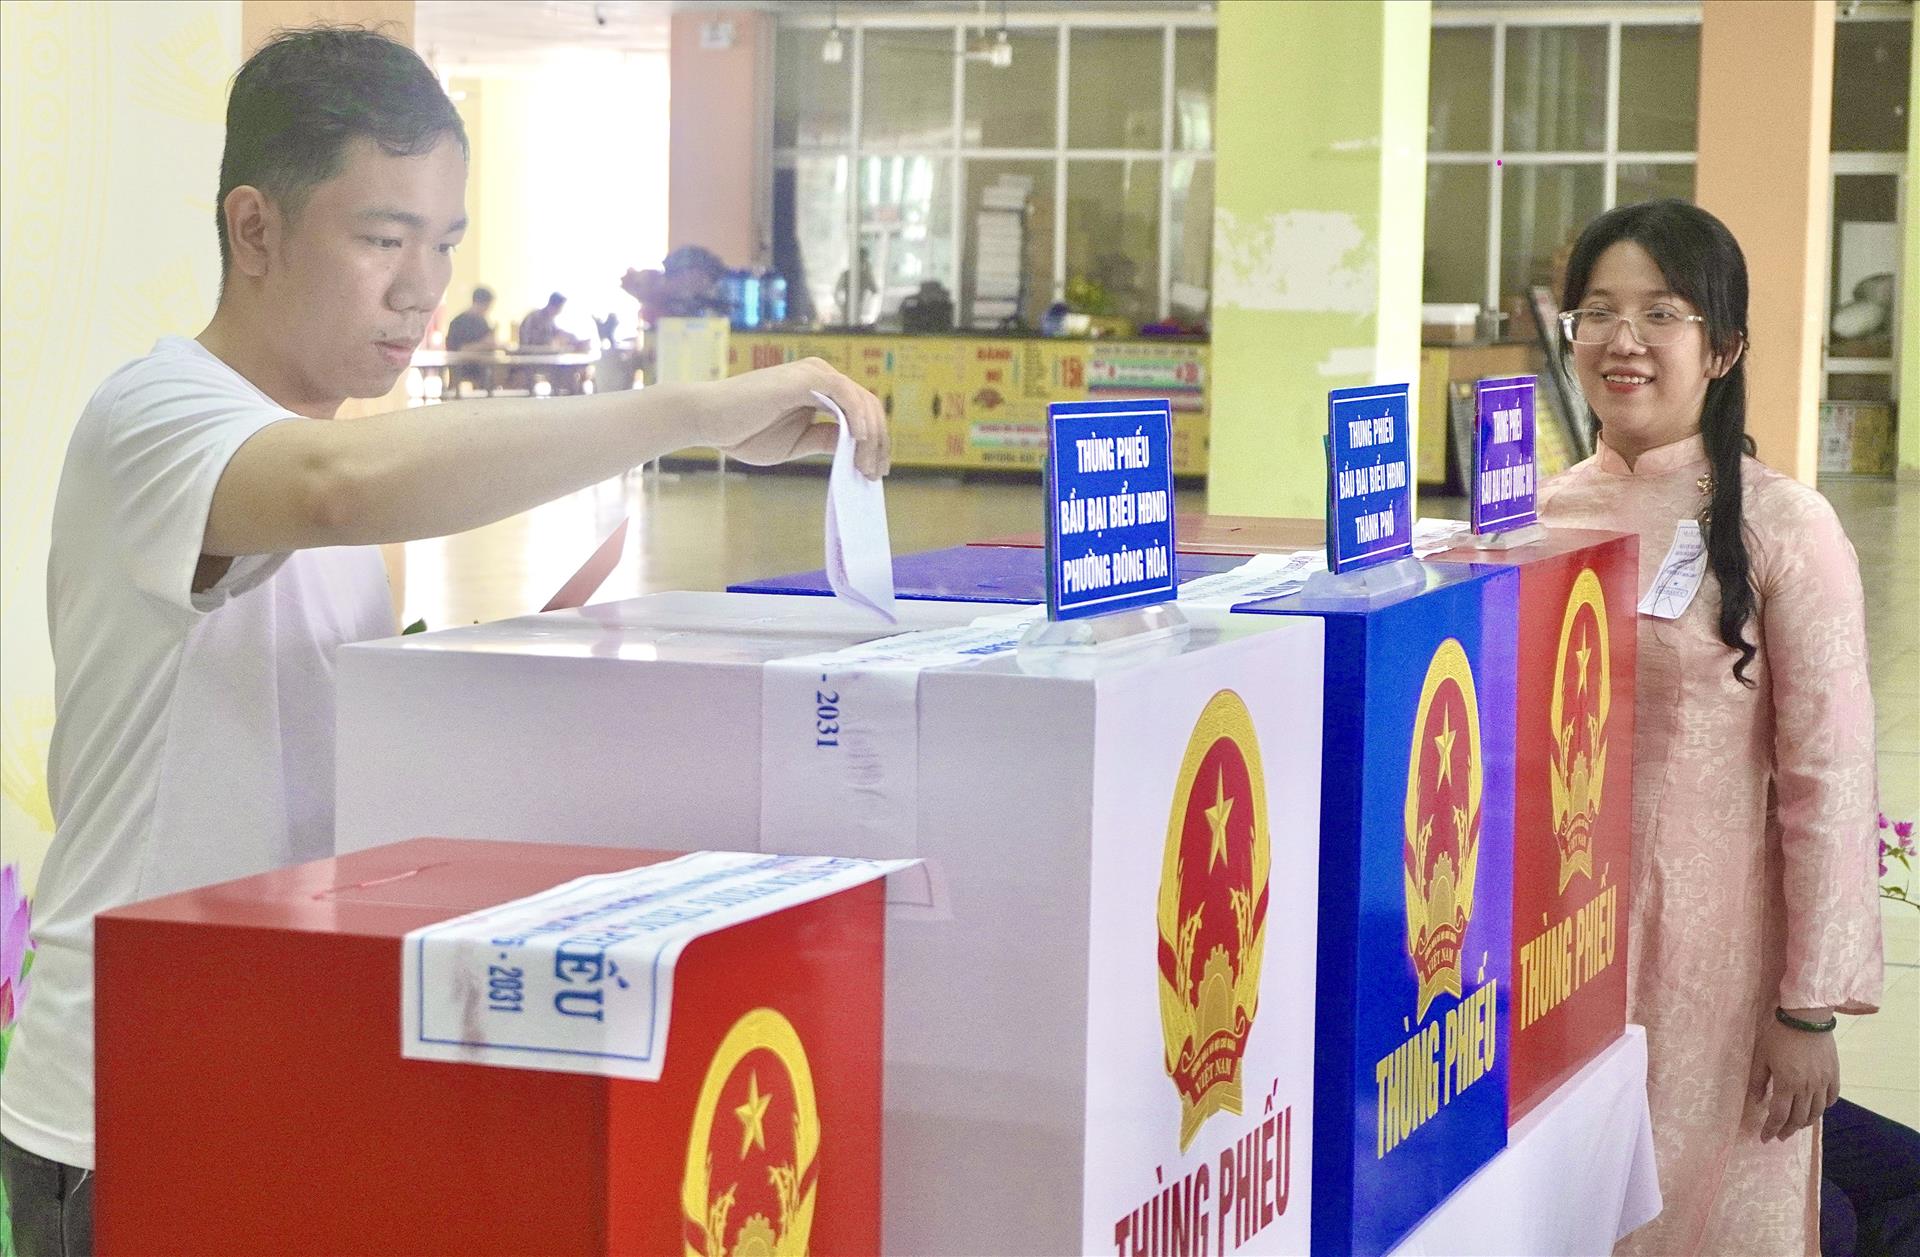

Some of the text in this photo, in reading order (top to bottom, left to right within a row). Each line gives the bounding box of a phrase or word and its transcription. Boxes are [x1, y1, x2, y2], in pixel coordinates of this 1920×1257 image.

[1076, 431, 1114, 473] THÙNG
[1117, 425, 1149, 469] PHIẾU
[1349, 408, 1394, 449] THÙNG PHIẾU
[1339, 454, 1406, 501] BẦU ĐẠI BIỂU HĐND
[1060, 481, 1167, 538] BẦU ĐẠI BIỂU HĐND
[1355, 500, 1394, 544] THÀNH PHỐ
[1063, 539, 1168, 594] PHƯỜNG ĐÔNG HÒA
[816, 690, 840, 748] 2031
[1520, 862, 1617, 1031] THÙNG PHIẾU
[488, 964, 524, 1013] 2031
[1195, 1062, 1215, 1093] VIỆT
[1215, 1057, 1233, 1077] NAM
[1376, 951, 1497, 1160] THÙNG PHIẾU
[1219, 1077, 1292, 1257] PHIẾU
